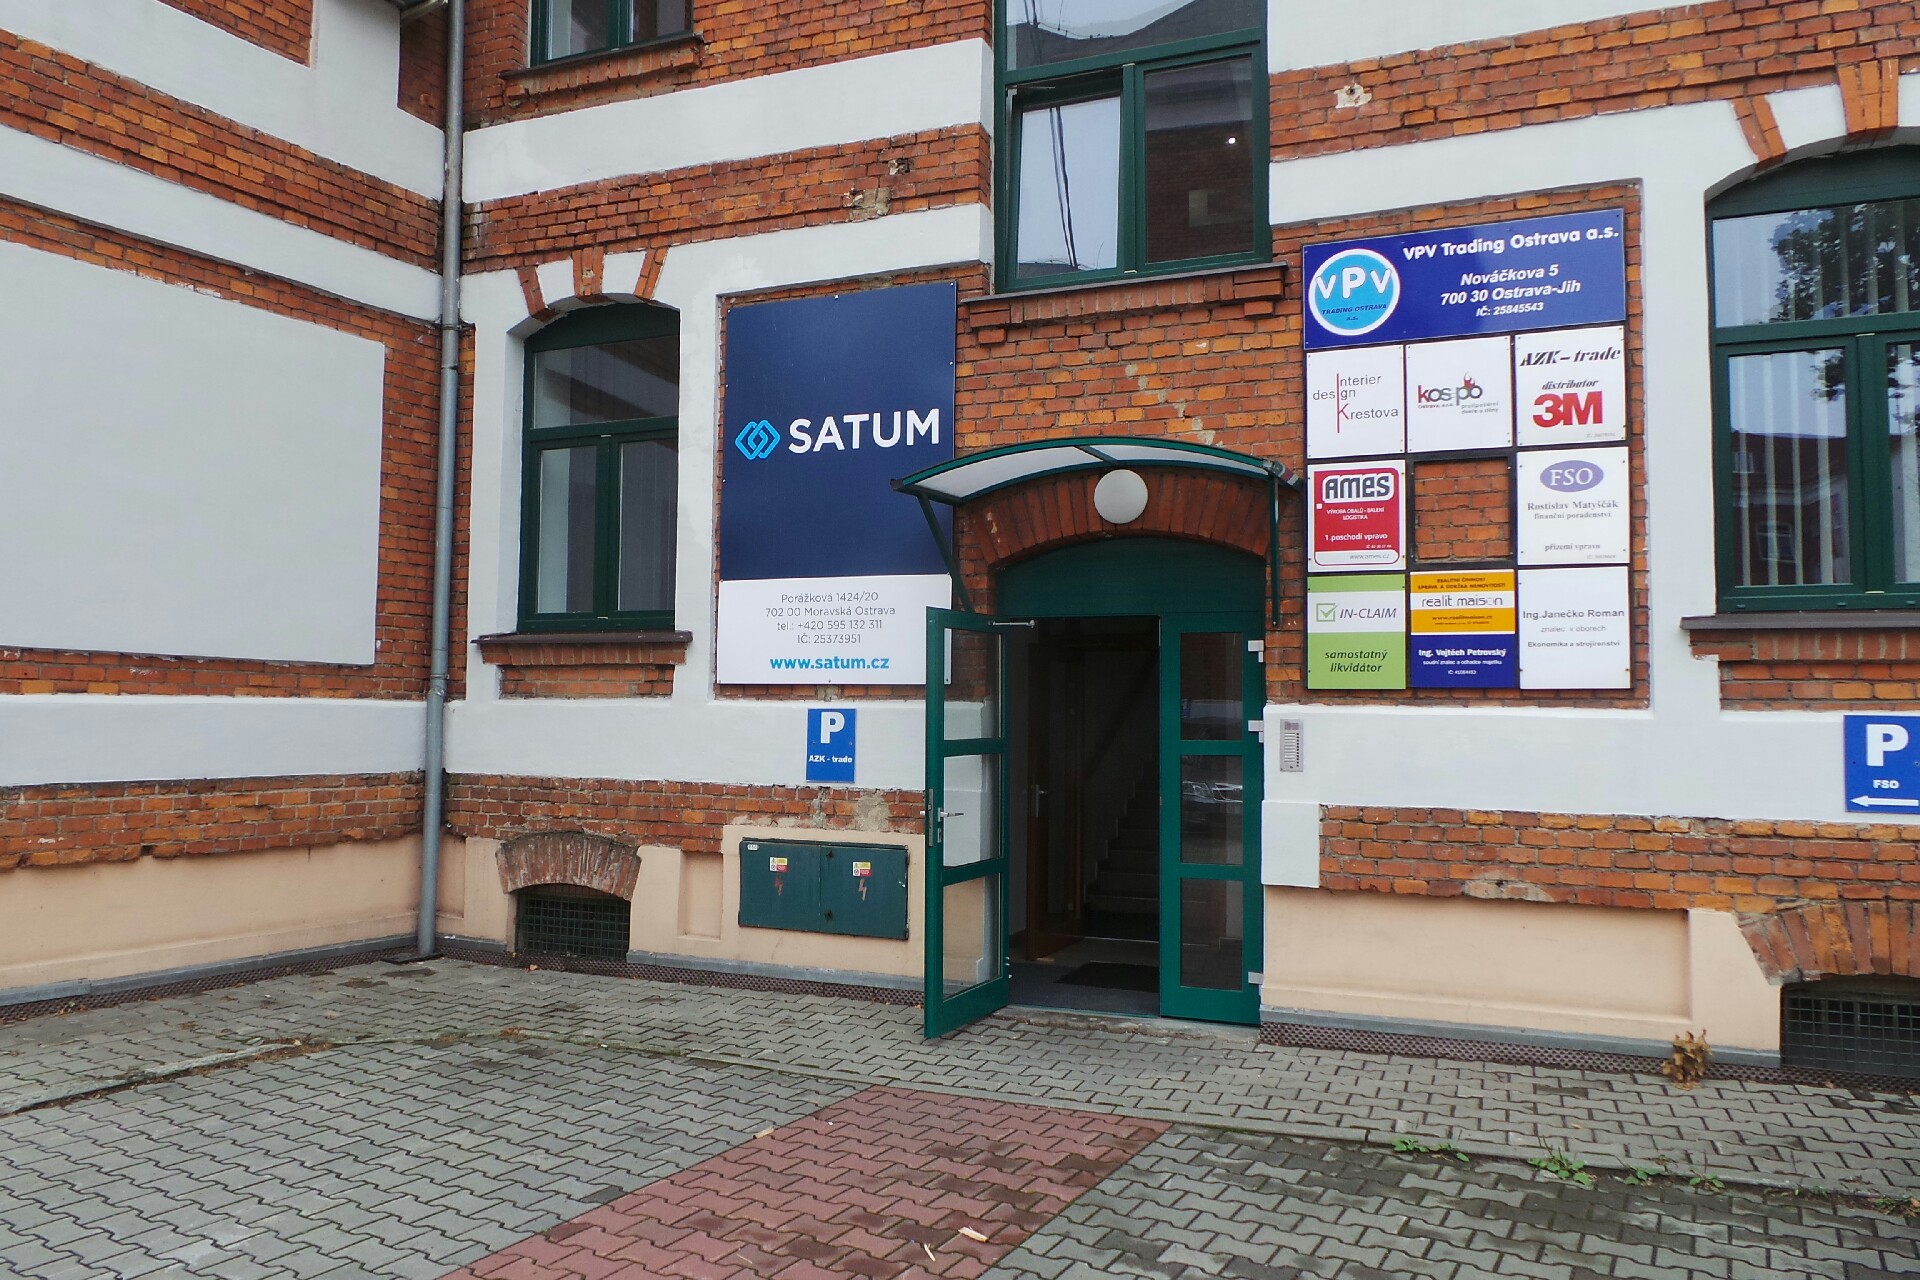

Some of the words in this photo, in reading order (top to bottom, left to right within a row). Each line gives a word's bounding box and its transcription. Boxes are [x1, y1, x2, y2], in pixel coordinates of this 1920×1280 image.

[1403, 244, 1437, 260] VPV
[1441, 238, 1504, 257] Trading
[1510, 228, 1580, 249] Ostrava
[1586, 225, 1619, 241] a.s.
[1460, 266, 1544, 286] Nováčkova
[1548, 264, 1559, 278] 5
[1315, 266, 1392, 299] VPV
[1441, 291, 1466, 306] 700
[1470, 290, 1488, 304] 30
[1491, 281, 1581, 302] Ostrava-Jih
[1322, 307, 1353, 315] TRADING
[1354, 304, 1387, 312] OSTRAVA
[1476, 305, 1491, 318] IČ:
[1493, 302, 1544, 316] 25845543
[1541, 379, 1599, 391] distributor
[1336, 403, 1399, 420] Krestova
[1533, 391, 1603, 428] 3M
[788, 408, 940, 454] SATUM
[1550, 467, 1594, 486] FSO
[1527, 502, 1570, 511] Rostislav
[1572, 500, 1619, 511] Matyščák
[1534, 512, 1565, 520] finanční
[1566, 511, 1611, 520] poradenství
[1363, 533, 1388, 541] vpravo
[1544, 543, 1573, 552] přízemí
[781, 593, 833, 603] Porážková
[836, 591, 879, 602] 1424/20
[1421, 595, 1453, 607] realit
[766, 607, 784, 617] 702
[786, 607, 801, 616] 00
[804, 606, 852, 616] Moravská
[855, 606, 896, 615] Ostrava
[1339, 608, 1397, 619] IN-CLAIM
[1587, 609, 1625, 618] Roman
[777, 621, 794, 631] tel.:
[797, 620, 824, 630] +420
[827, 620, 846, 630] 595
[849, 620, 866, 630] 132
[868, 619, 882, 629] 311
[797, 634, 811, 644] IČ:
[813, 634, 861, 644] 25373951
[1325, 649, 1388, 661] samostatný
[1418, 649, 1434, 657] Ing.
[1435, 648, 1466, 657] Vojtěch
[1466, 648, 1507, 657] Petrovský
[770, 656, 890, 670] www.satum.cz
[1330, 662, 1382, 673] likvidátor
[820, 711, 845, 743] P
[1866, 724, 1909, 766] P
[808, 754, 826, 763] AZK
[831, 755, 853, 763] trade
[1872, 779, 1900, 789] FSO
